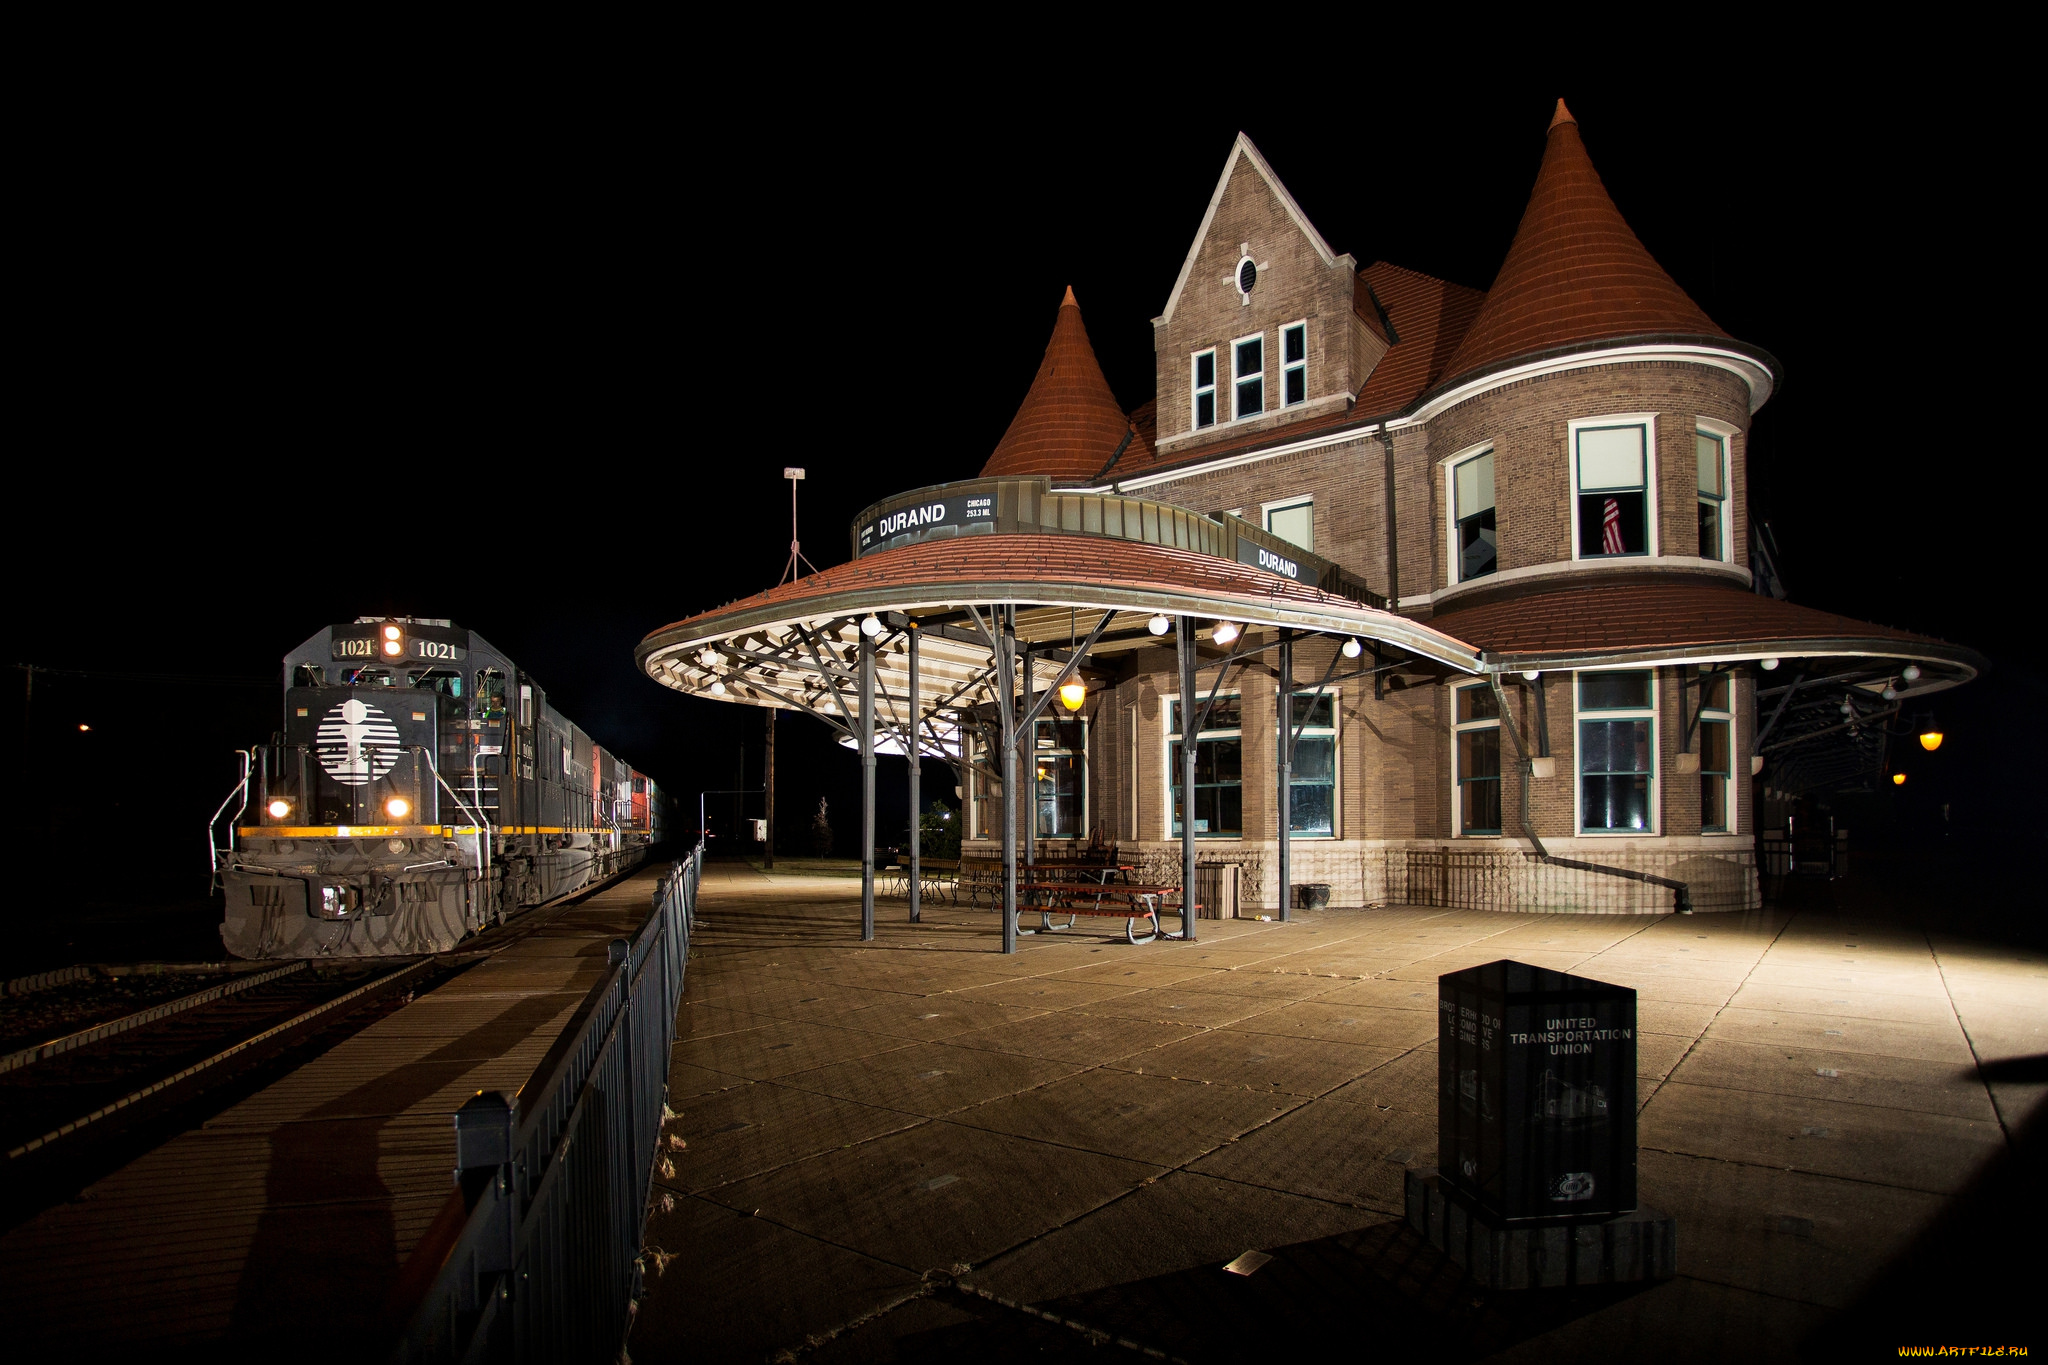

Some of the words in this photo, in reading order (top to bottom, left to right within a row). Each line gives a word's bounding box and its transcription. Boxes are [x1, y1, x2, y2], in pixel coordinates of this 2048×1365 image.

[967, 498, 991, 508] CHICAGO
[880, 504, 946, 538] DURAND
[966, 509, 982, 518] 253.3
[1259, 549, 1298, 579] DURAND
[340, 639, 373, 656] 1021
[418, 641, 458, 660] 1021
[1440, 999, 1490, 1026] BROTERHD
[1447, 1014, 1493, 1040] LOMOVE
[1546, 1018, 1597, 1031] UNITED
[1450, 1026, 1490, 1051] EGINES
[1510, 1028, 1632, 1045] TRANSPORTATION
[1550, 1043, 1593, 1056] UNION
